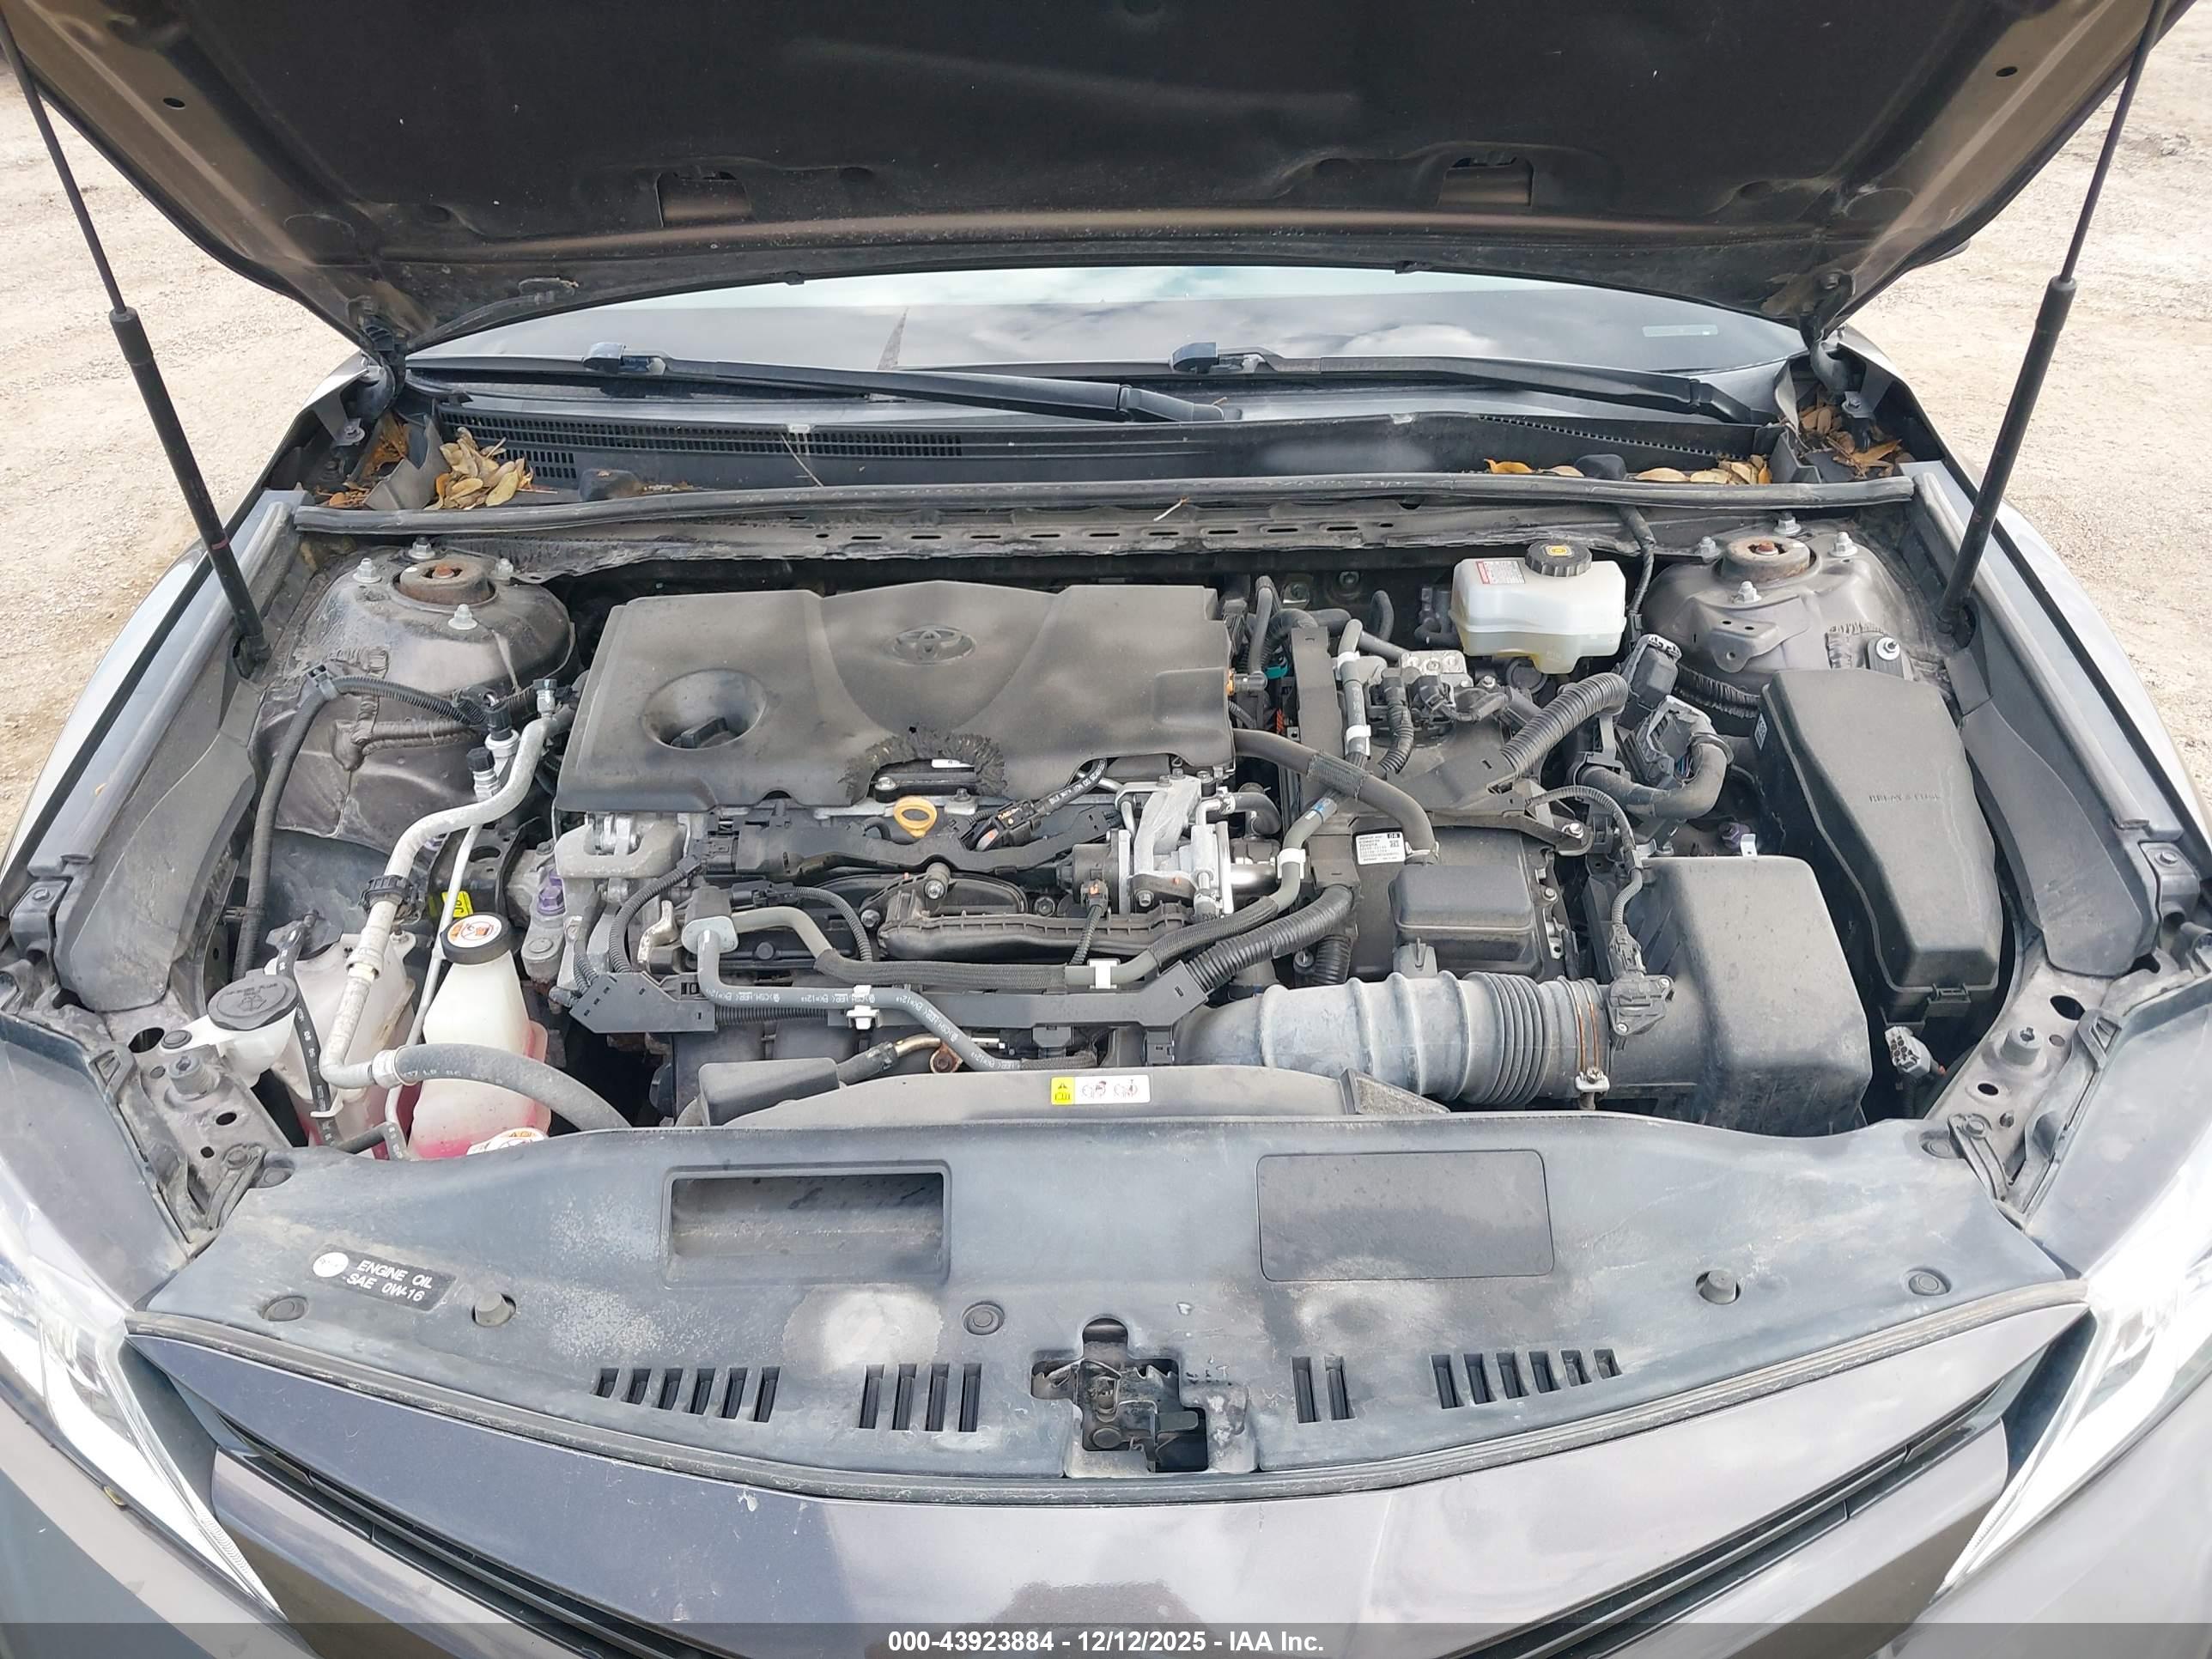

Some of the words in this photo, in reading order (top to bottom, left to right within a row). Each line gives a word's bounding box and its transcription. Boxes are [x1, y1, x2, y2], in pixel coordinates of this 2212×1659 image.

[347, 1273, 377, 1289] SAE
[382, 1282, 425, 1302] 0W-16
[357, 1260, 408, 1281] ENGINE
[412, 1274, 433, 1289] OIL
